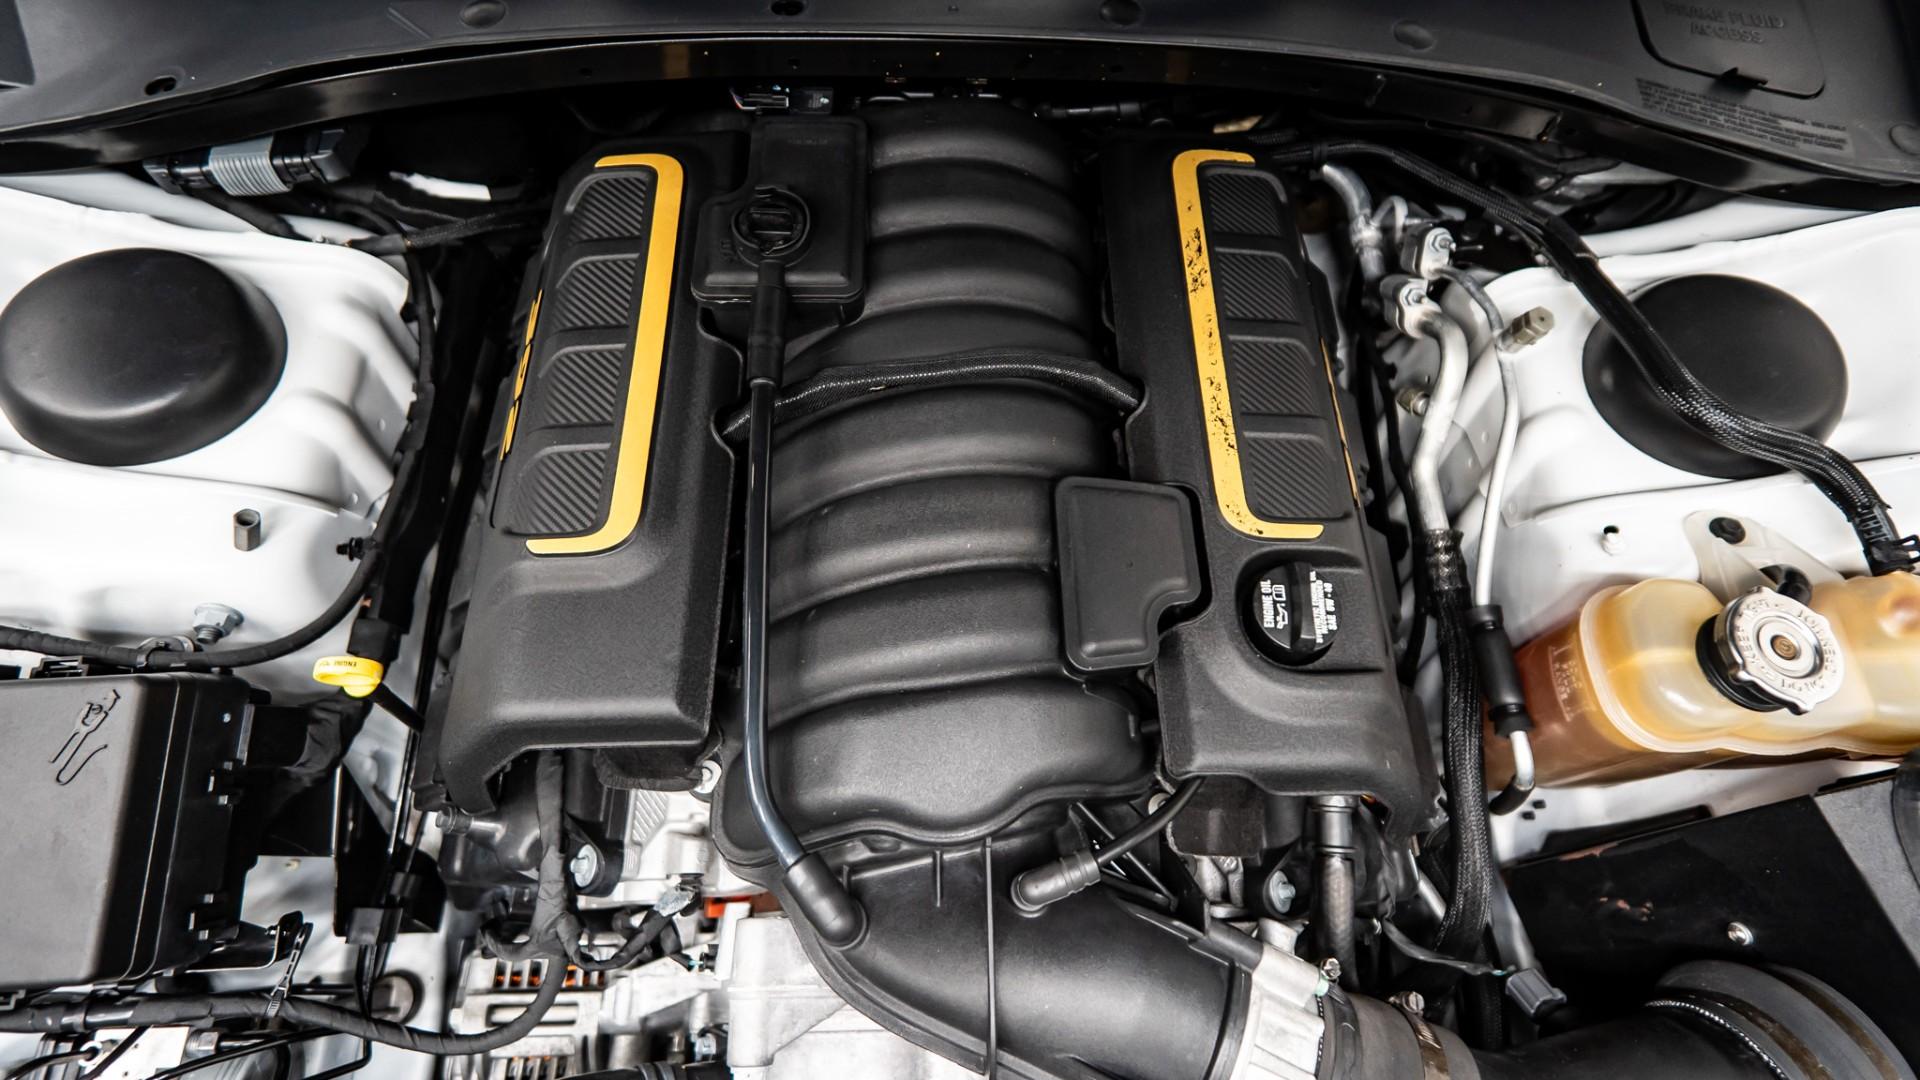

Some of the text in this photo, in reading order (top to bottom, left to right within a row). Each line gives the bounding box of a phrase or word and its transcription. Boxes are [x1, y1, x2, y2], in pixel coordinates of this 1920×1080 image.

[1728, 10, 1784, 29] FLUID
[1690, 22, 1764, 44] ACCESS
[1260, 579, 1275, 628] ENGINE OIL
[1327, 614, 1338, 630] SAE
